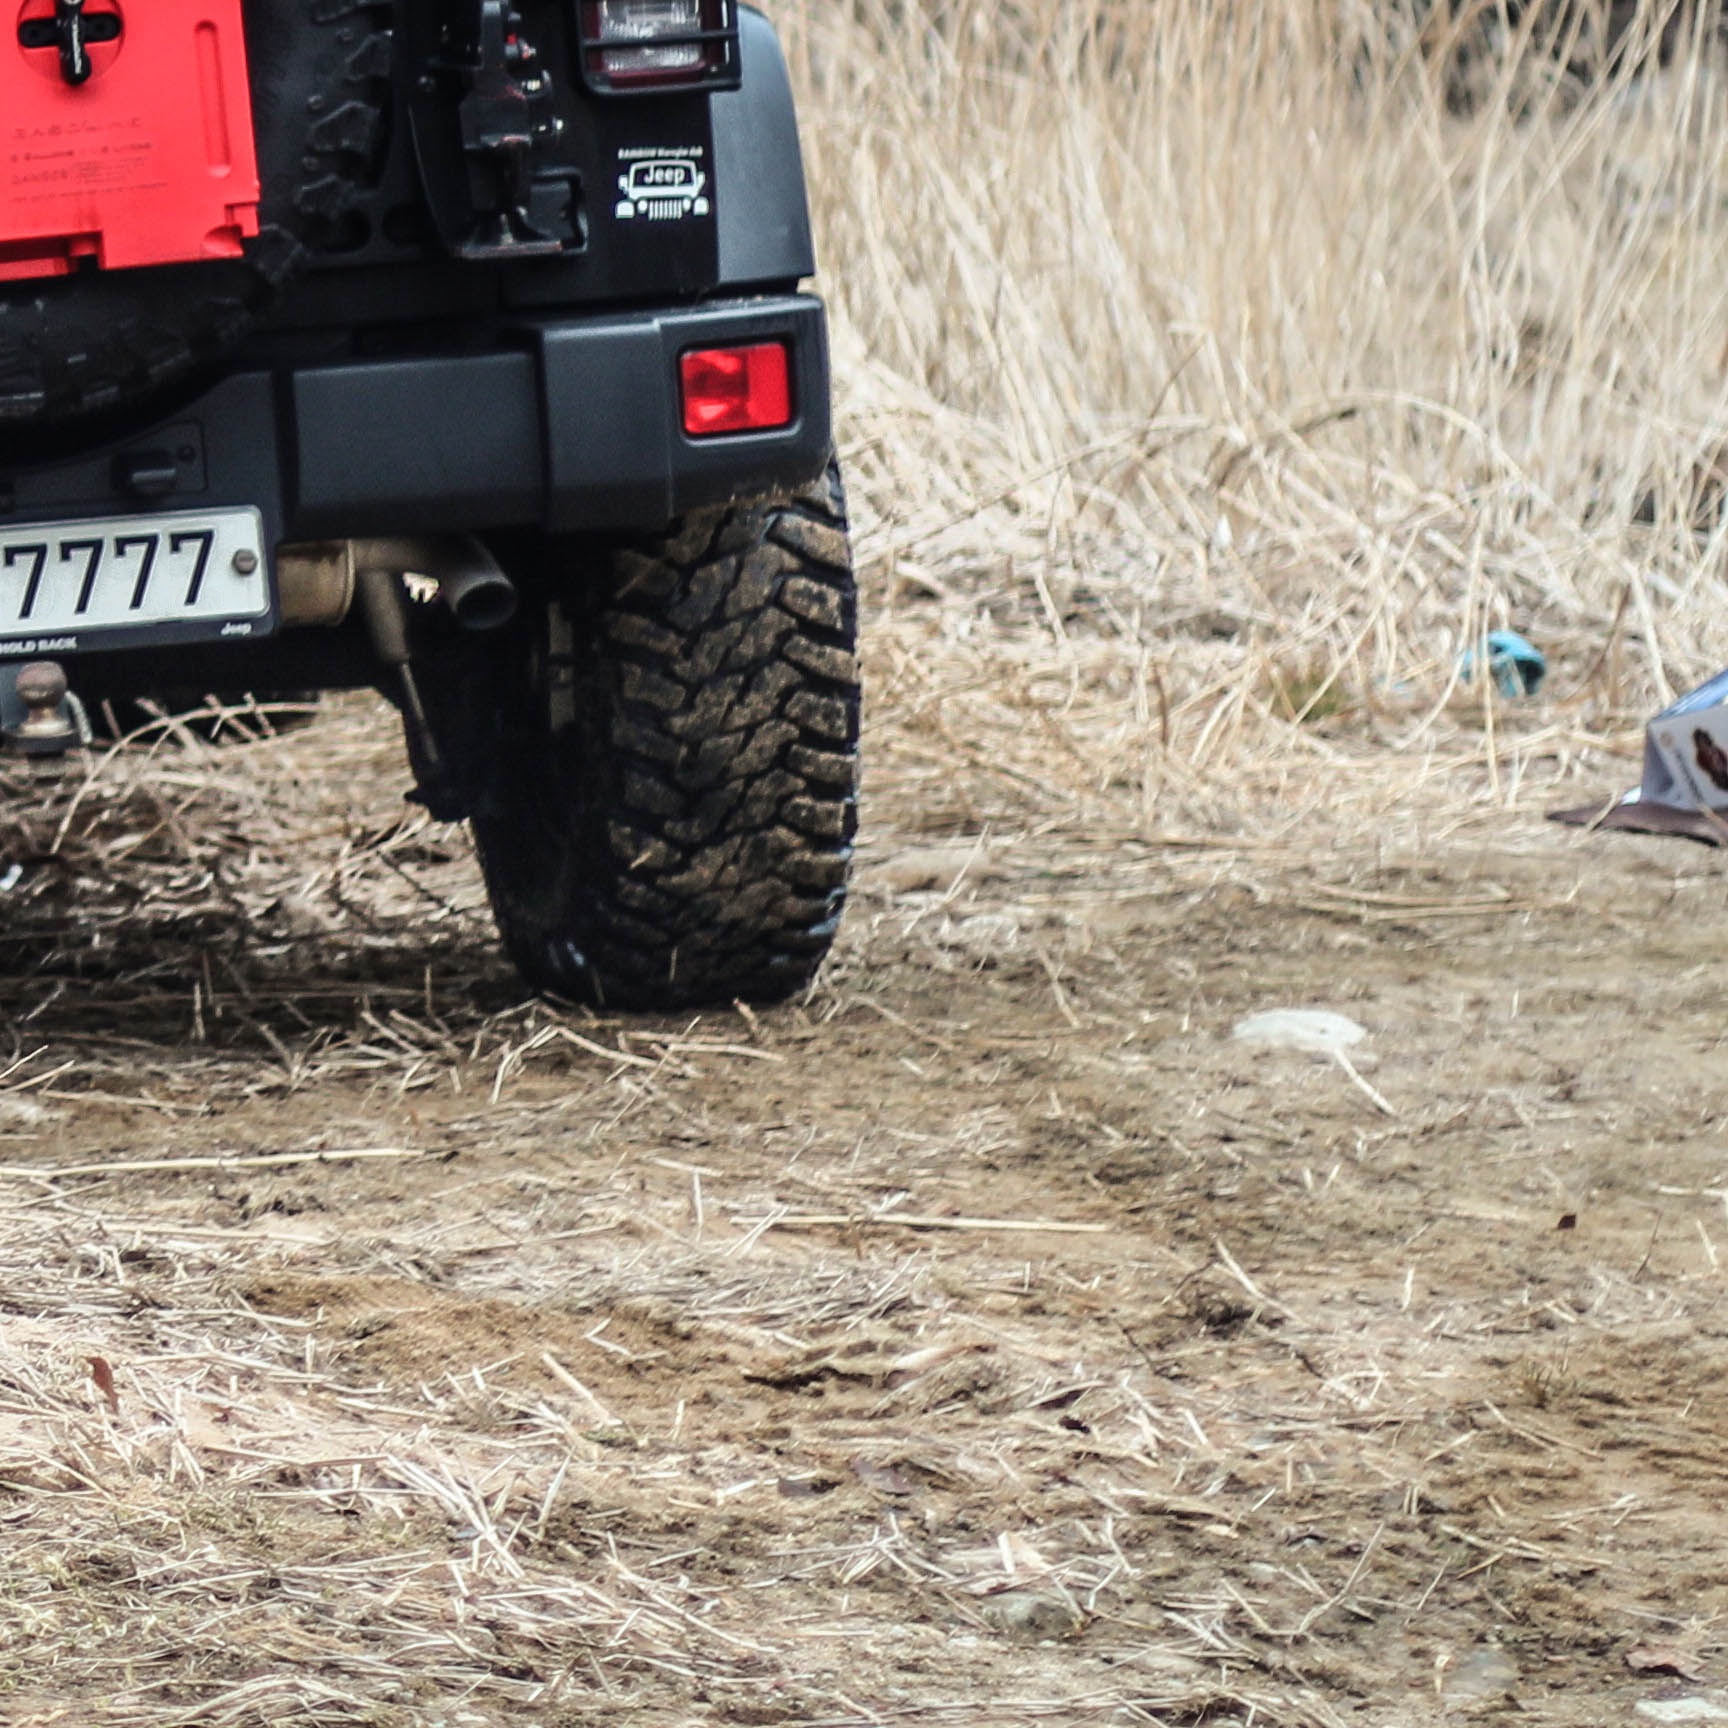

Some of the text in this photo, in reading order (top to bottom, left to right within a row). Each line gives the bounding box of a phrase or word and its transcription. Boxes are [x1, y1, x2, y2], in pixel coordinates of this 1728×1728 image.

[644, 165, 685, 187] Jeep
[2, 529, 216, 620] 7777
[38, 636, 77, 651] BACK
